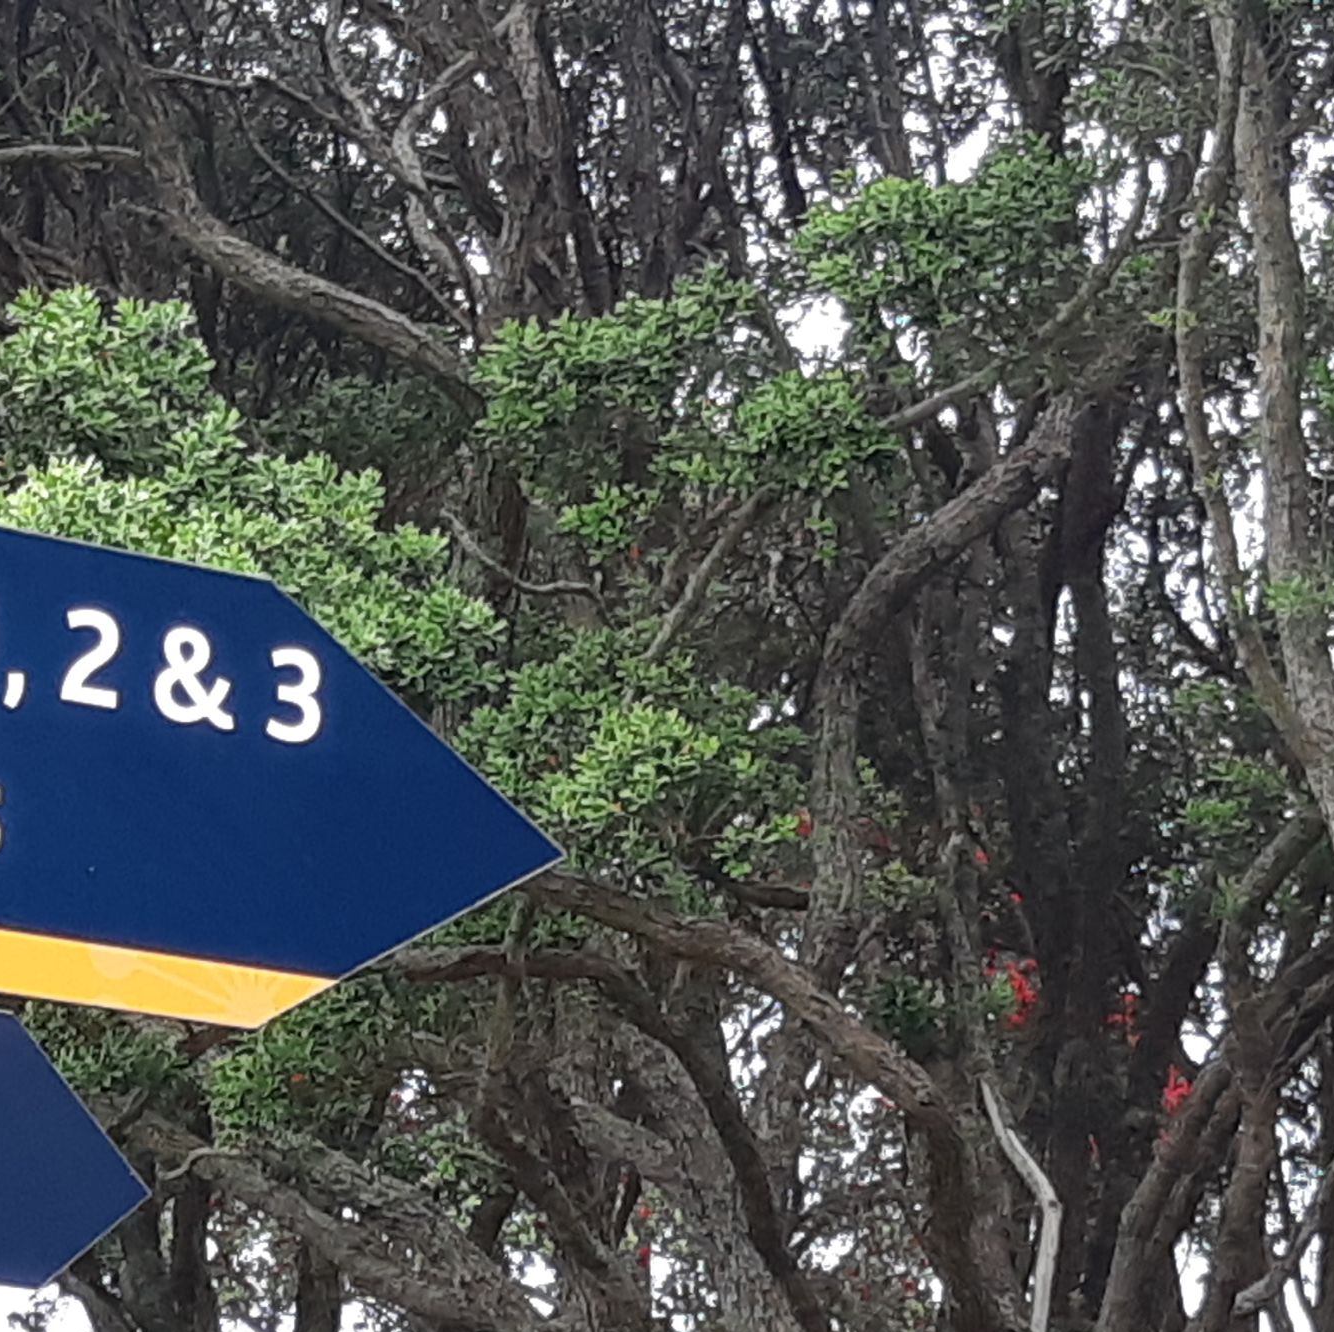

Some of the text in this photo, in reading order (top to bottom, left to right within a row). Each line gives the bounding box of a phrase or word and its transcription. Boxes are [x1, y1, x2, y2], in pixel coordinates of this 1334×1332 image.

[60, 608, 120, 709] 2
[153, 626, 235, 730] &
[266, 647, 322, 743] 3
